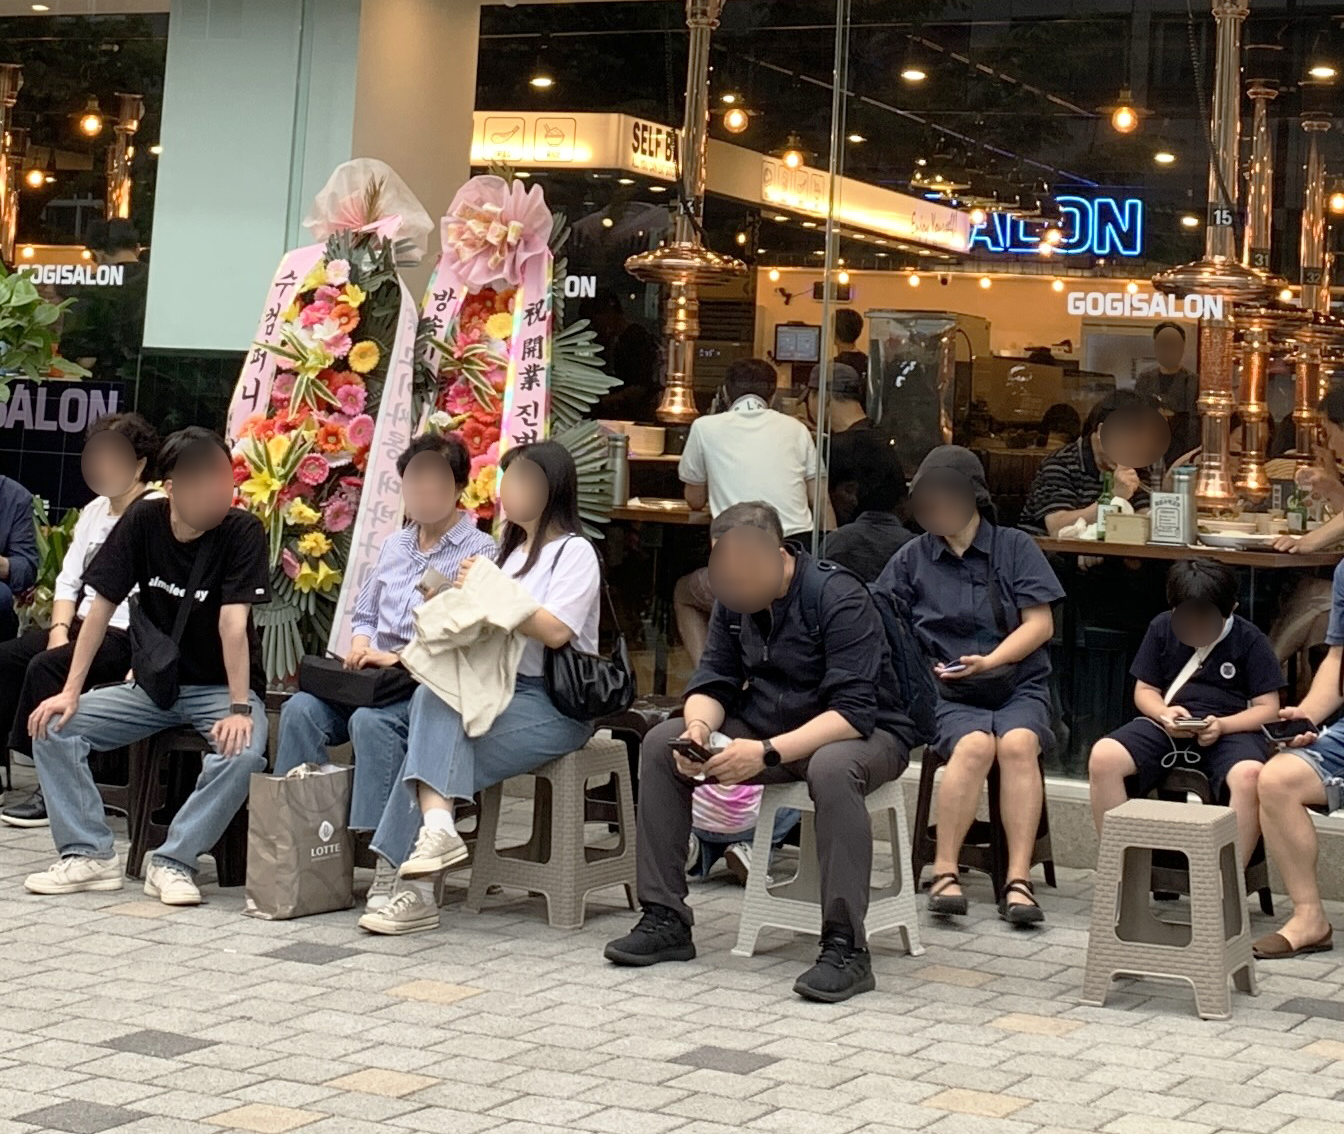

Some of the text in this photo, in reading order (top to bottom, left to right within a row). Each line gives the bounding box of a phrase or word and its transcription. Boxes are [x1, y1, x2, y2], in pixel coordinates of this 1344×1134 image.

[632, 121, 663, 160] SELF
[1214, 209, 1233, 226] 15
[1067, 291, 1224, 320] GOGISALON
[311, 843, 341, 857] LOTTE
